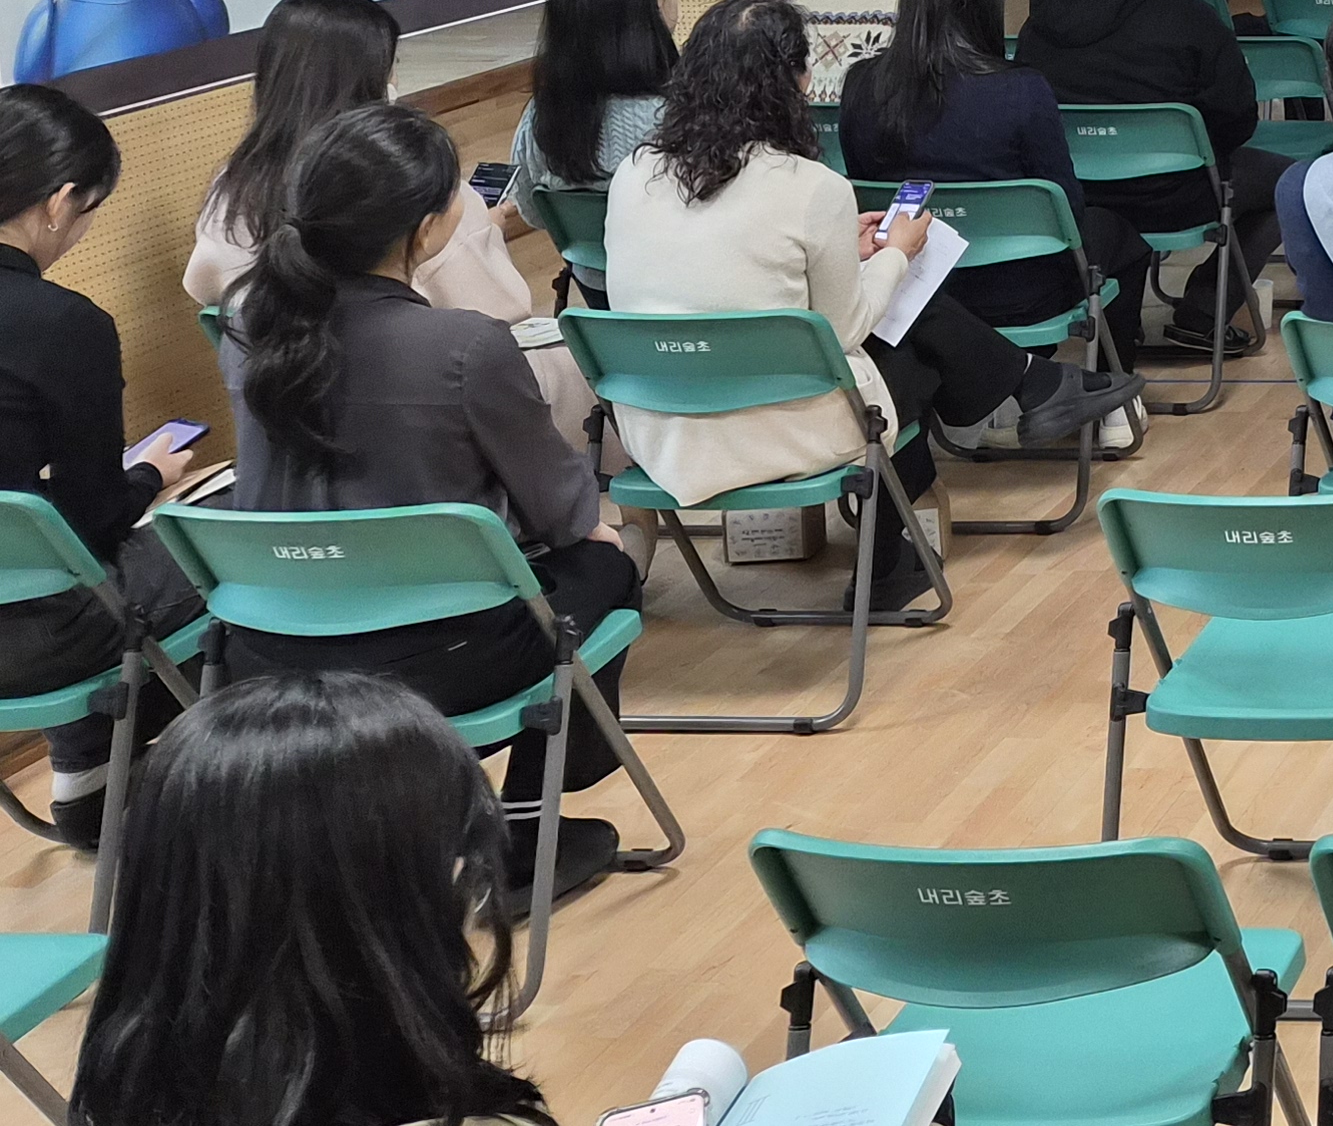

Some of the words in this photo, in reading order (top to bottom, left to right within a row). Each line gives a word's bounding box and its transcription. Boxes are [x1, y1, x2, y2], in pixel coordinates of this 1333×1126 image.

[1077, 127, 1118, 135] 내리숲초
[932, 208, 967, 218] 리숲초
[655, 341, 710, 352] 내리숲초
[1225, 531, 1293, 543] 내리숲초
[273, 546, 345, 559] 내리숲초
[918, 888, 1010, 905] 내리숲초
